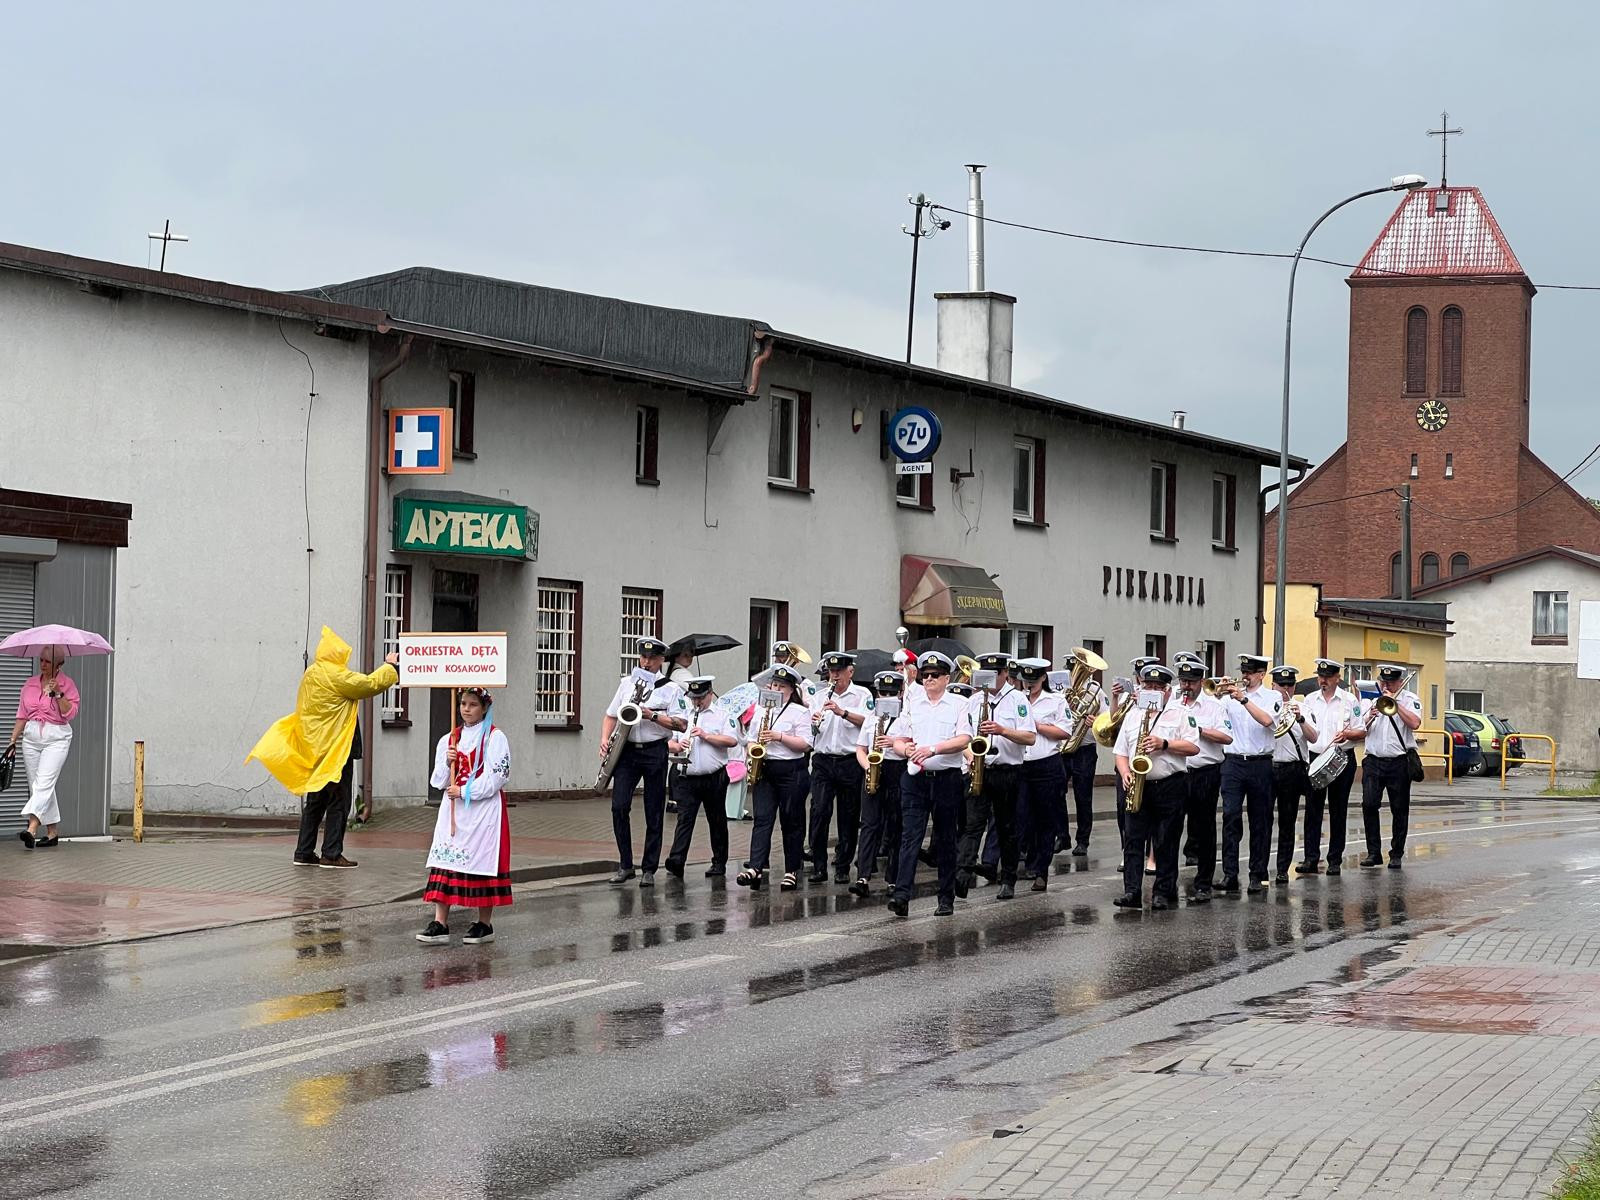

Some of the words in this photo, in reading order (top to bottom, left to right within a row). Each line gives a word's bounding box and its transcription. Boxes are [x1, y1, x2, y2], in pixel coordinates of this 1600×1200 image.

[899, 422, 927, 445] PZU
[405, 508, 524, 550] APTEKA
[1103, 565, 1205, 606] PIEKARNIA
[405, 646, 463, 656] ORKIESTRA
[471, 646, 499, 657] DĘTA
[407, 665, 438, 673] GMINY
[445, 665, 496, 673] KOSAKOWO
